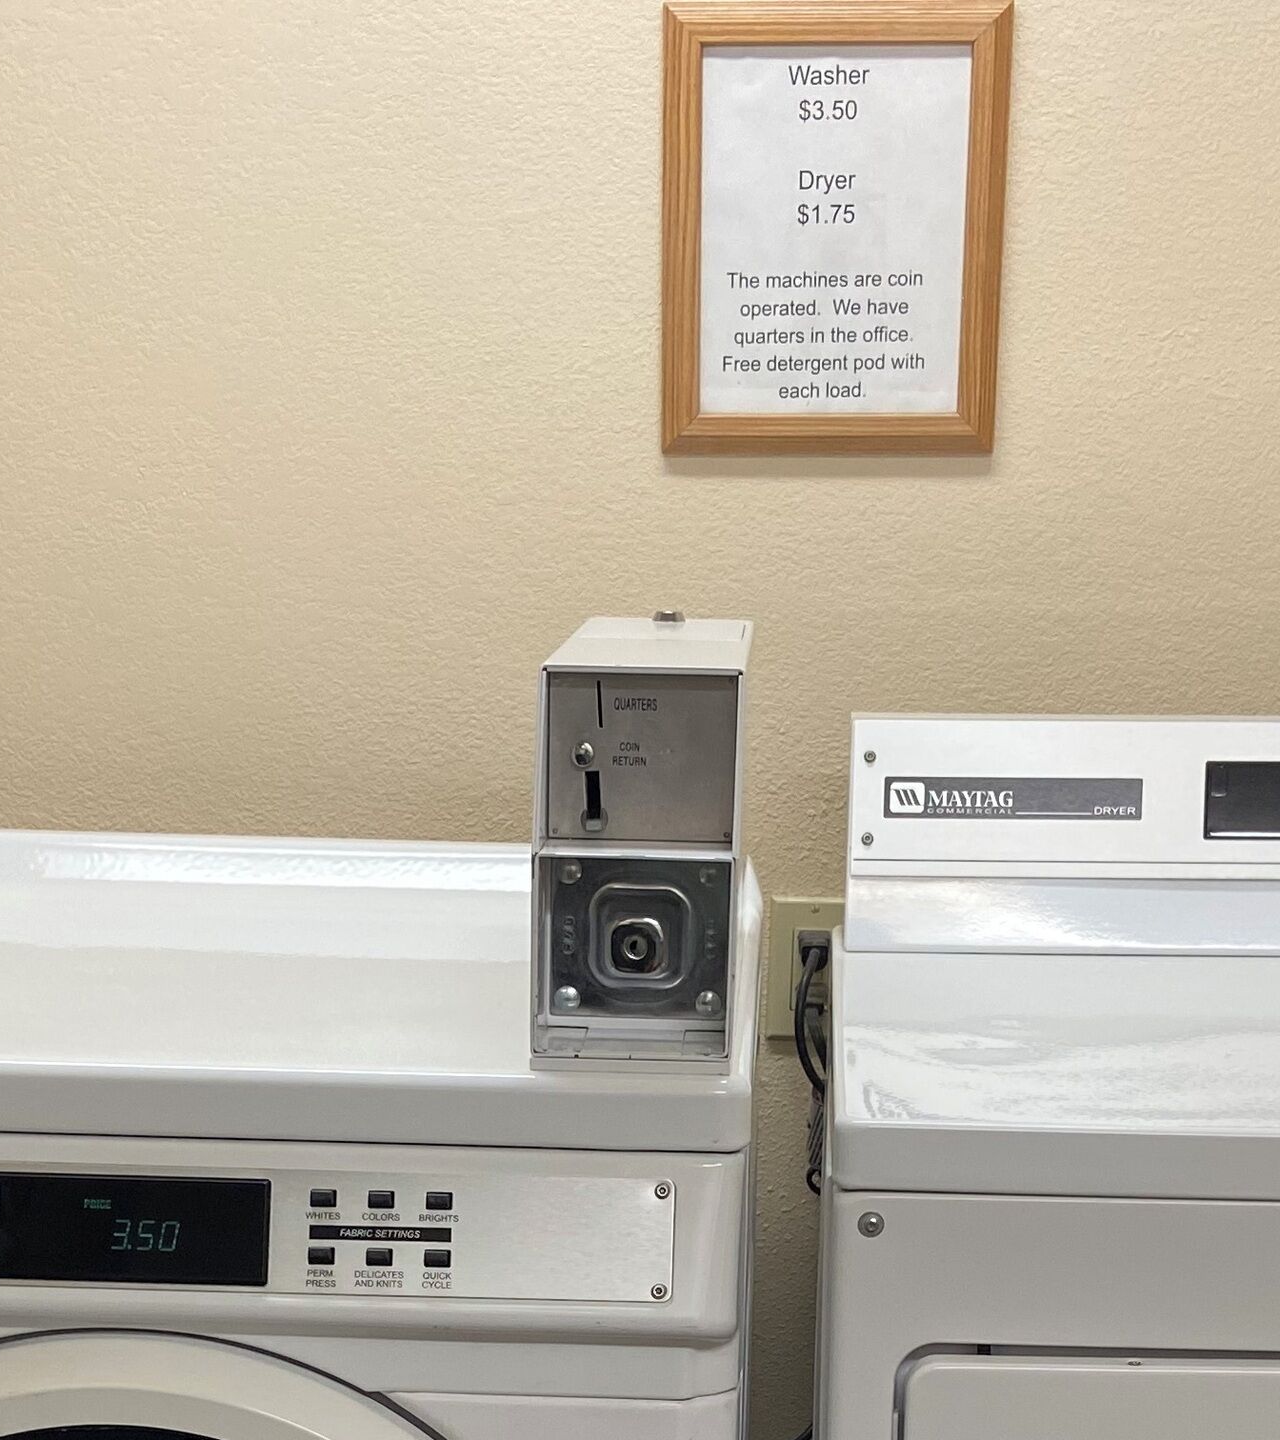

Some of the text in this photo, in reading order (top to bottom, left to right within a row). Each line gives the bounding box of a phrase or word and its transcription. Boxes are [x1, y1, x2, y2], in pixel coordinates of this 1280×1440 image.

[788, 65, 870, 86] Washer
[798, 99, 858, 122] $3.50
[798, 170, 856, 194] Dryer
[797, 204, 856, 226] $1.75
[727, 270, 924, 289] The machines are coin
[739, 299, 910, 319] operated. We have
[733, 326, 914, 348] quarters in the office.
[722, 353, 926, 376] Free detergent pod with
[778, 381, 866, 399] each load.
[613, 697, 658, 713] QUARTERS
[619, 741, 641, 752] COIN
[611, 755, 647, 767] RETURN
[927, 789, 1014, 808] MAYTAG
[926, 807, 1015, 816] COMMERCIAL
[1093, 806, 1136, 816] DRYER
[305, 1211, 341, 1221] WHITES
[361, 1212, 401, 1222] COLORS
[418, 1213, 459, 1223] BRIGHTS
[110, 1219, 181, 1252] 3.50
[339, 1228, 421, 1240] FABRIC SETTINGS
[354, 1269, 404, 1280] DELICATES
[422, 1271, 452, 1281] QUICK
[305, 1279, 337, 1289] PRESS
[354, 1279, 403, 1289] AND KNITS
[421, 1280, 452, 1290] CYCLE
